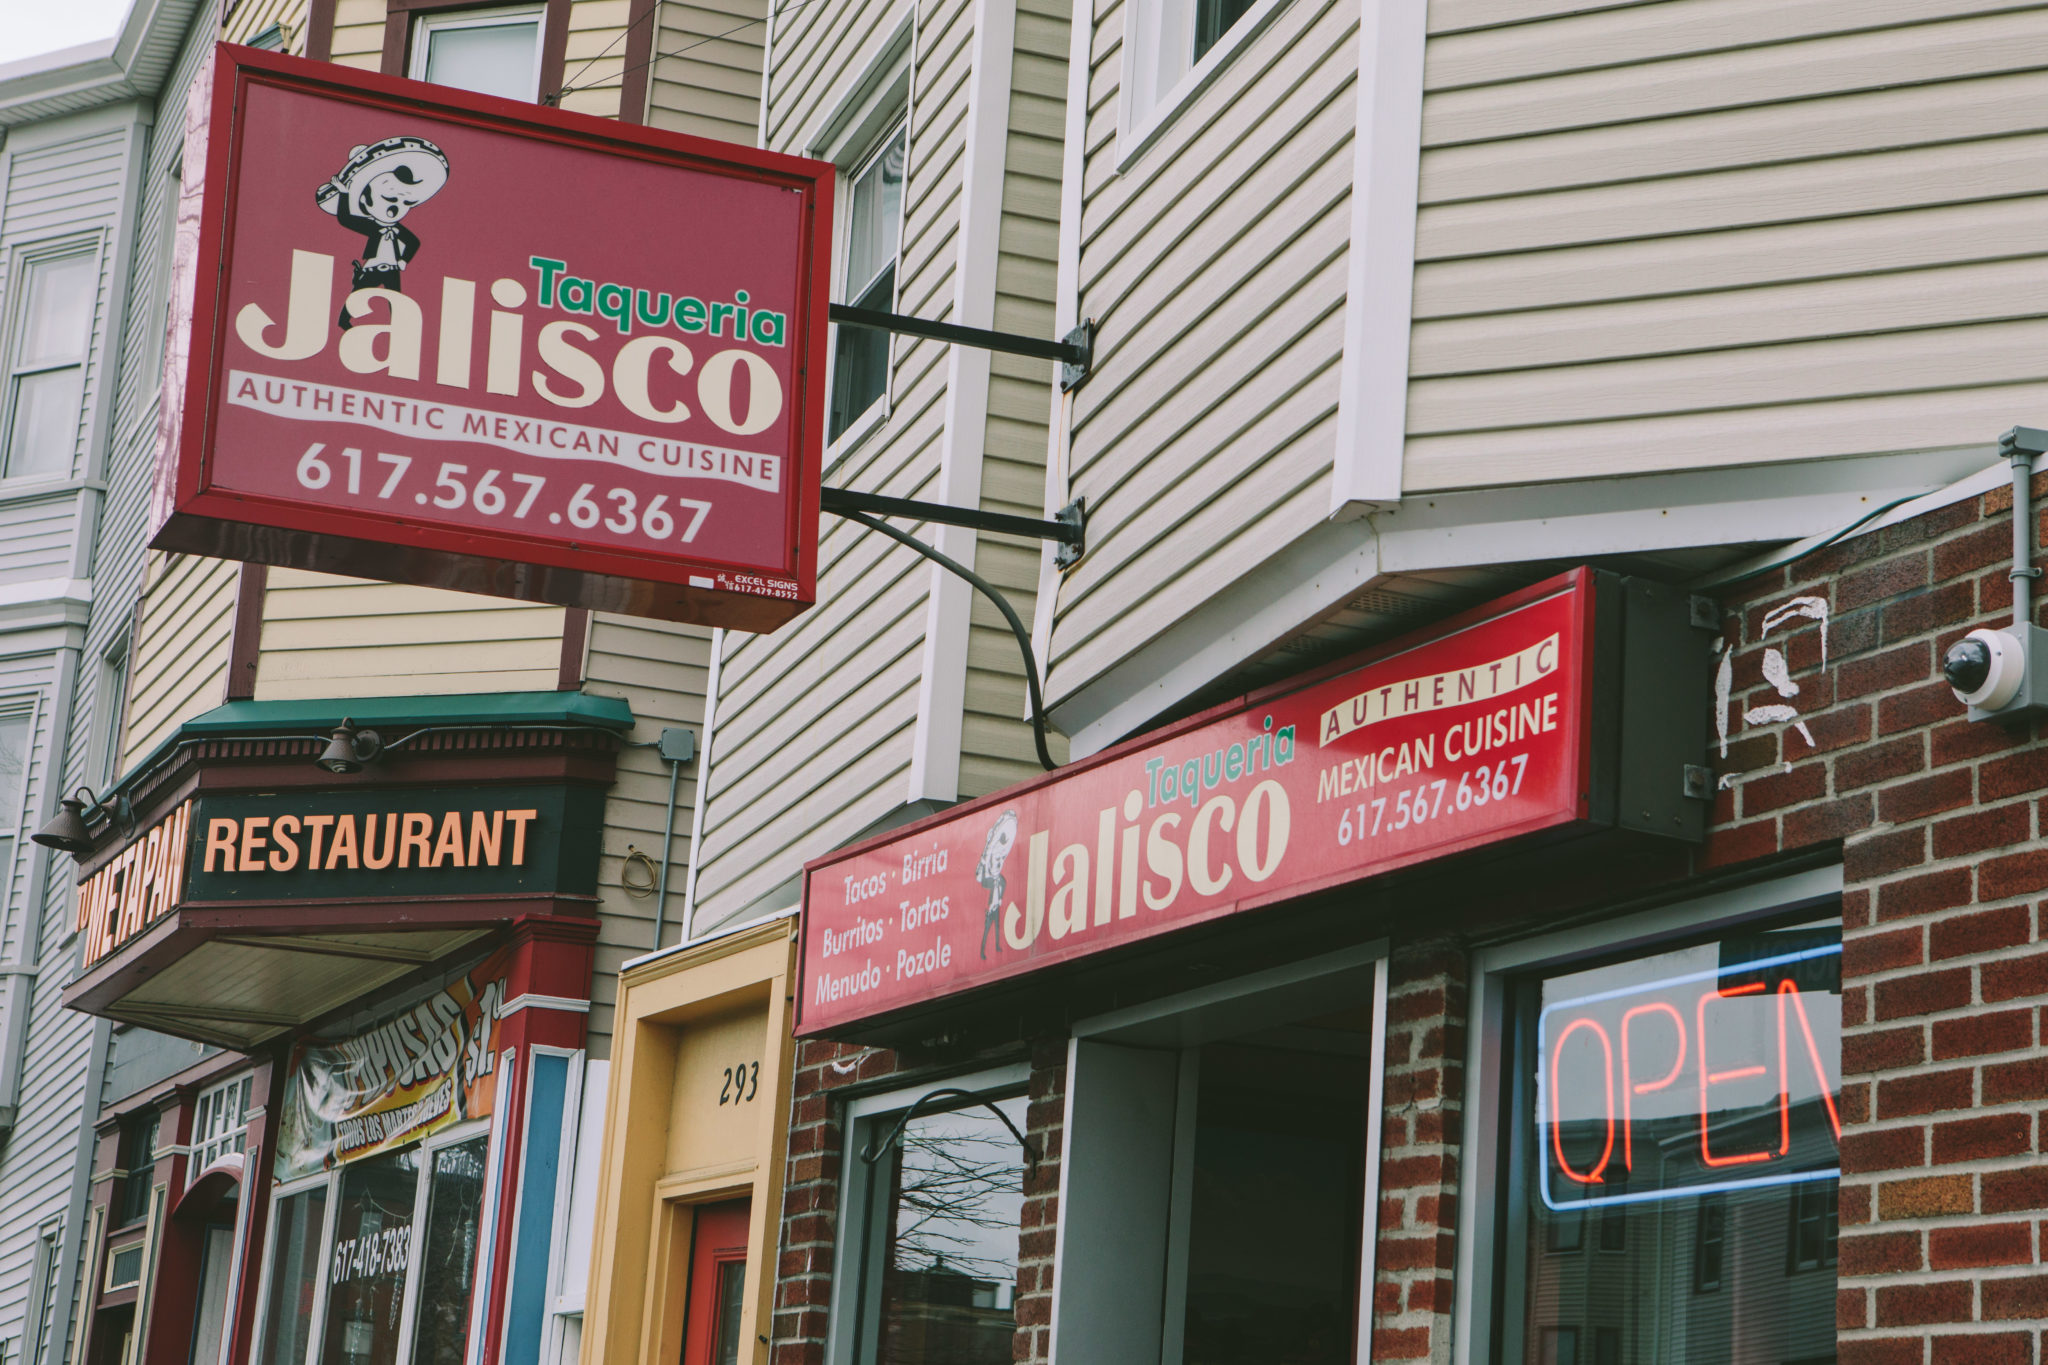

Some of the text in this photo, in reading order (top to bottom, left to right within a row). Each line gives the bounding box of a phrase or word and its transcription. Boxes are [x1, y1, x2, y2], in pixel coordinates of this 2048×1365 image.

[235, 248, 783, 436] Jalisco
[529, 255, 786, 346] Taqueria
[238, 377, 774, 481] AUTHENTIC MEXICAN CUISINE
[296, 442, 712, 544] 617.567.6367
[734, 584, 798, 600] 617-479-8552
[735, 575, 765, 587] EXCEL
[767, 579, 798, 591] SIGNS
[1325, 640, 1553, 742] AUTHENTIC
[1145, 715, 1295, 808] Taqueria
[1316, 692, 1558, 803] MEXICAN CUISINE
[203, 809, 537, 873] RESTAURANT
[1337, 753, 1529, 846] 617.567.6367
[82, 799, 192, 969] METAPAN
[844, 842, 948, 906] Tacos Birria
[1003, 779, 1291, 950] Jalisco
[815, 935, 951, 1006] Menudo Pozole
[822, 896, 949, 958] Burritos Tortas
[719, 1060, 760, 1106] 293
[1551, 979, 1842, 1183] OPEN
[339, 1116, 367, 1151] TODOS
[365, 1113, 386, 1144] LOS
[333, 1225, 411, 1284] 617-418-7383
